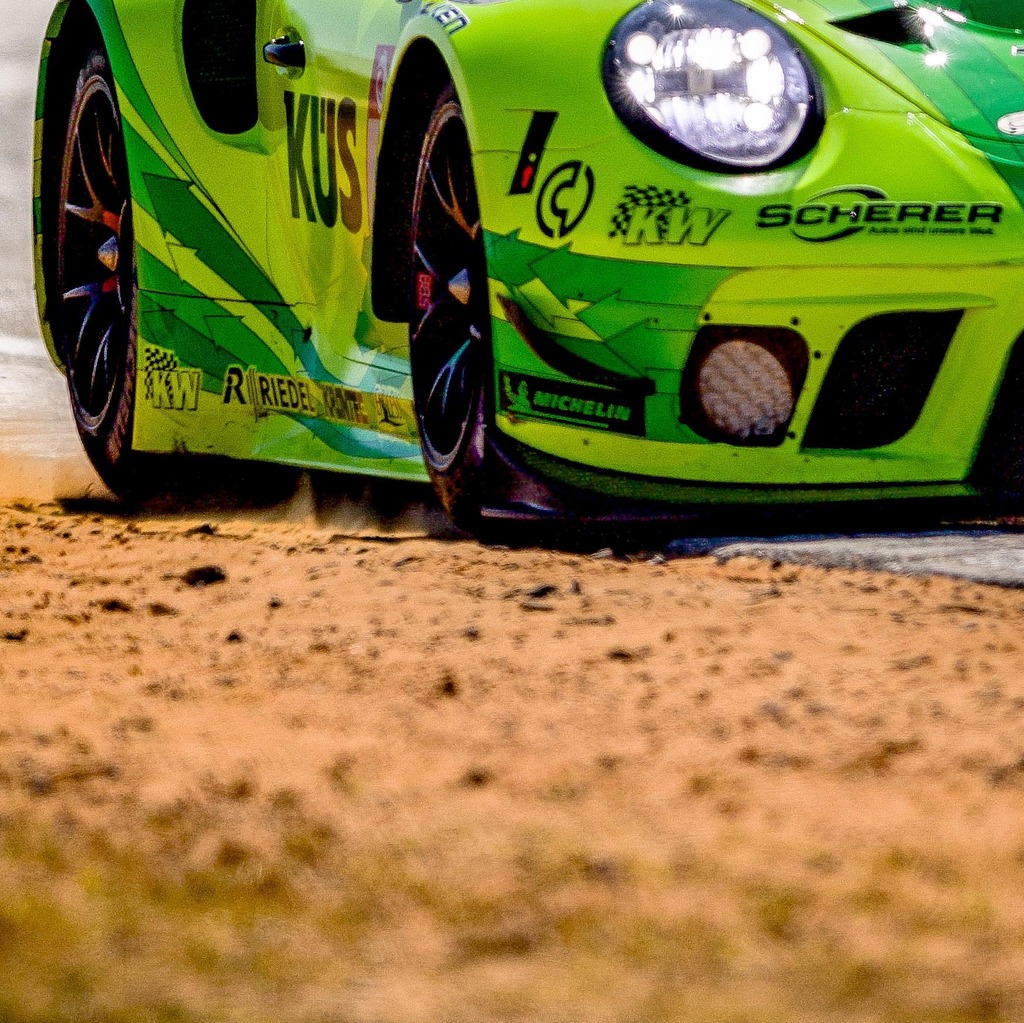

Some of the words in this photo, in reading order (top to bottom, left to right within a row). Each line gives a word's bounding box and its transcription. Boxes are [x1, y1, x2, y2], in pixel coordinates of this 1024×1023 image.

[622, 204, 732, 247] KW
[755, 201, 1004, 229] SCHERER
[261, 374, 317, 413] RIEDEL
[532, 390, 632, 422] MICHELIN
